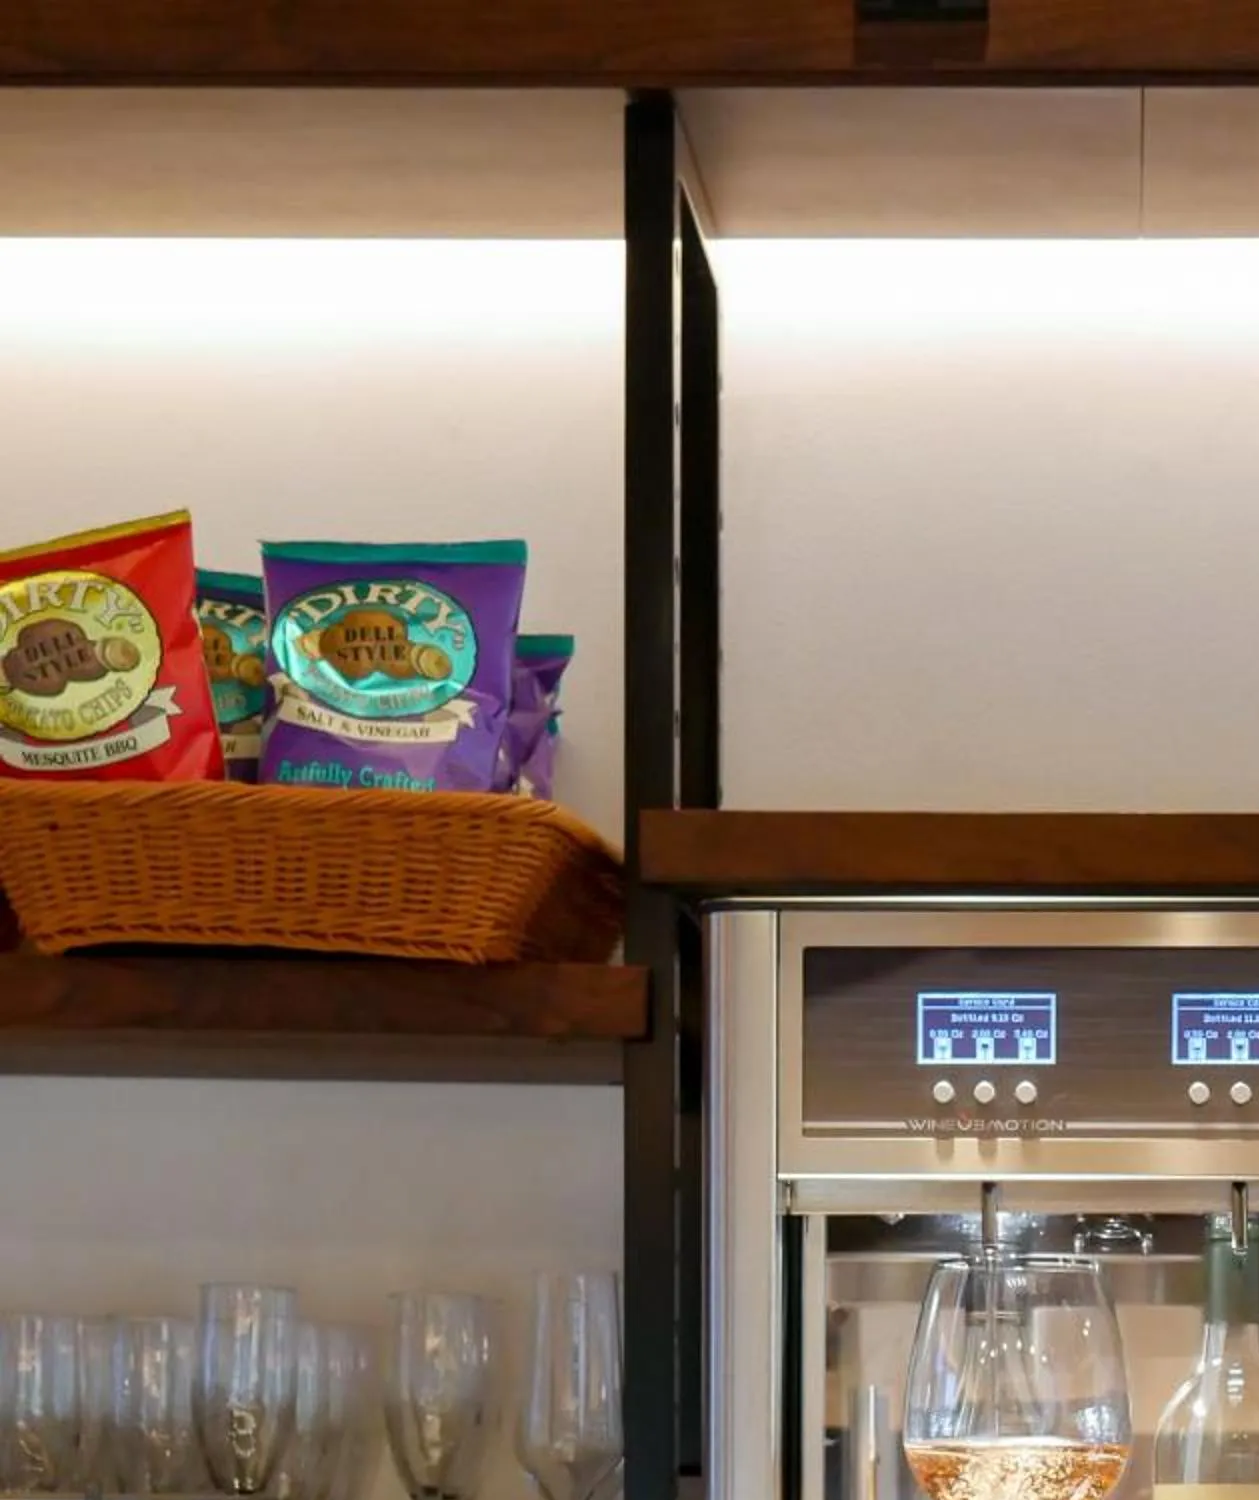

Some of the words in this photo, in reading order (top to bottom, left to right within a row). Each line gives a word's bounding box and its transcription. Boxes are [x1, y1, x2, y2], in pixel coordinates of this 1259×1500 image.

[24, 630, 77, 663] DELI
[344, 625, 398, 643] DELI
[24, 649, 89, 682] STYLE
[337, 645, 407, 662] STYLE
[78, 677, 134, 726] CHIPS
[297, 706, 334, 728] SALT
[357, 723, 431, 738] VINEGAR
[21, 746, 100, 766] MESQUITE
[103, 737, 138, 758] BBQ
[279, 760, 352, 789] Artfully
[360, 766, 437, 793] Crafted
